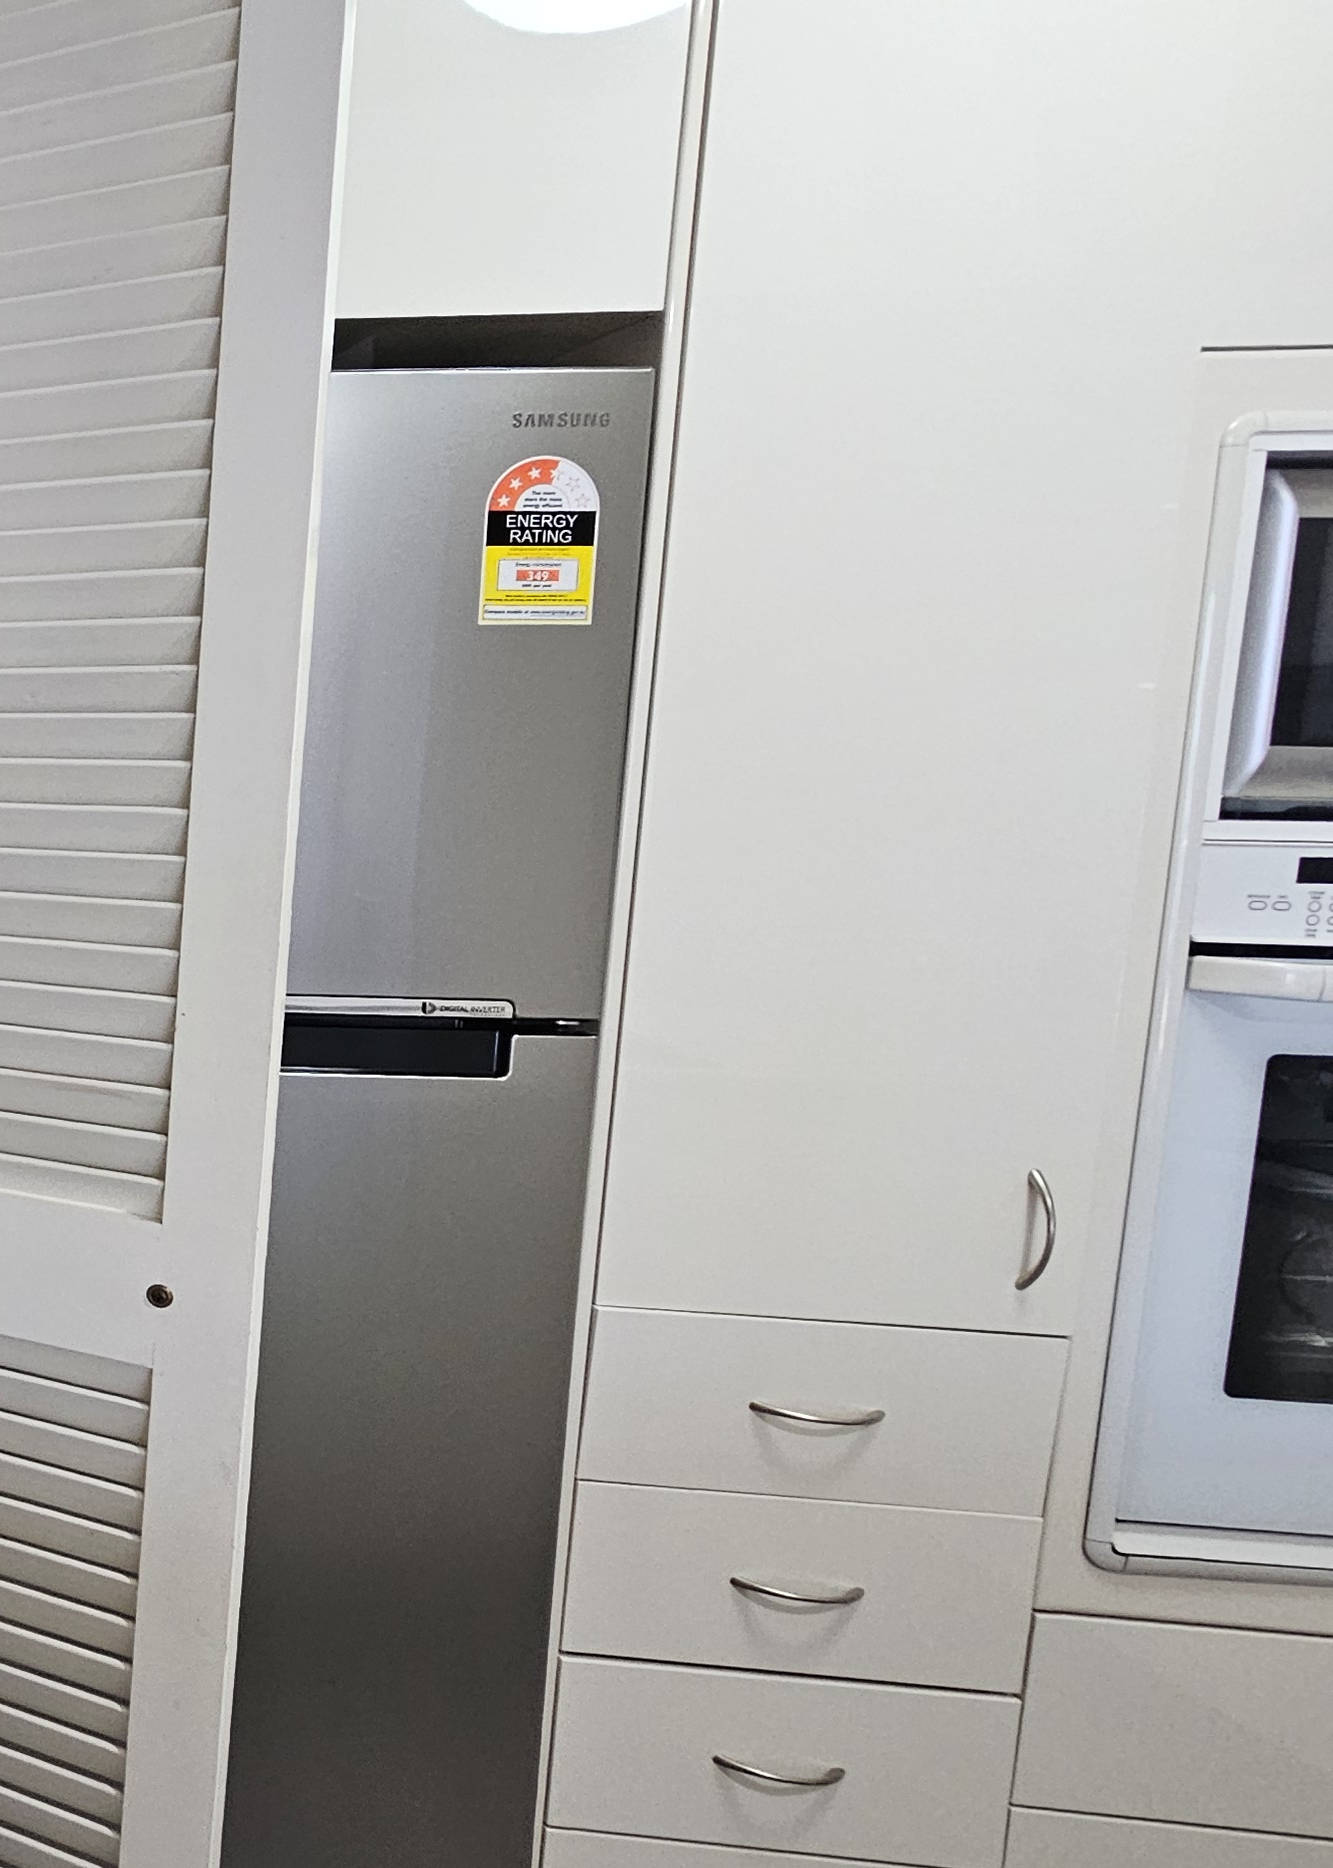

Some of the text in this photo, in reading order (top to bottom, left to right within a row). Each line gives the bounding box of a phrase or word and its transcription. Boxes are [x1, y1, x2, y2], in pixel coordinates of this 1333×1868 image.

[512, 411, 611, 429] SAMSUNG
[505, 513, 579, 528] ENERGY
[509, 529, 573, 544] RATING
[526, 570, 550, 582] 349
